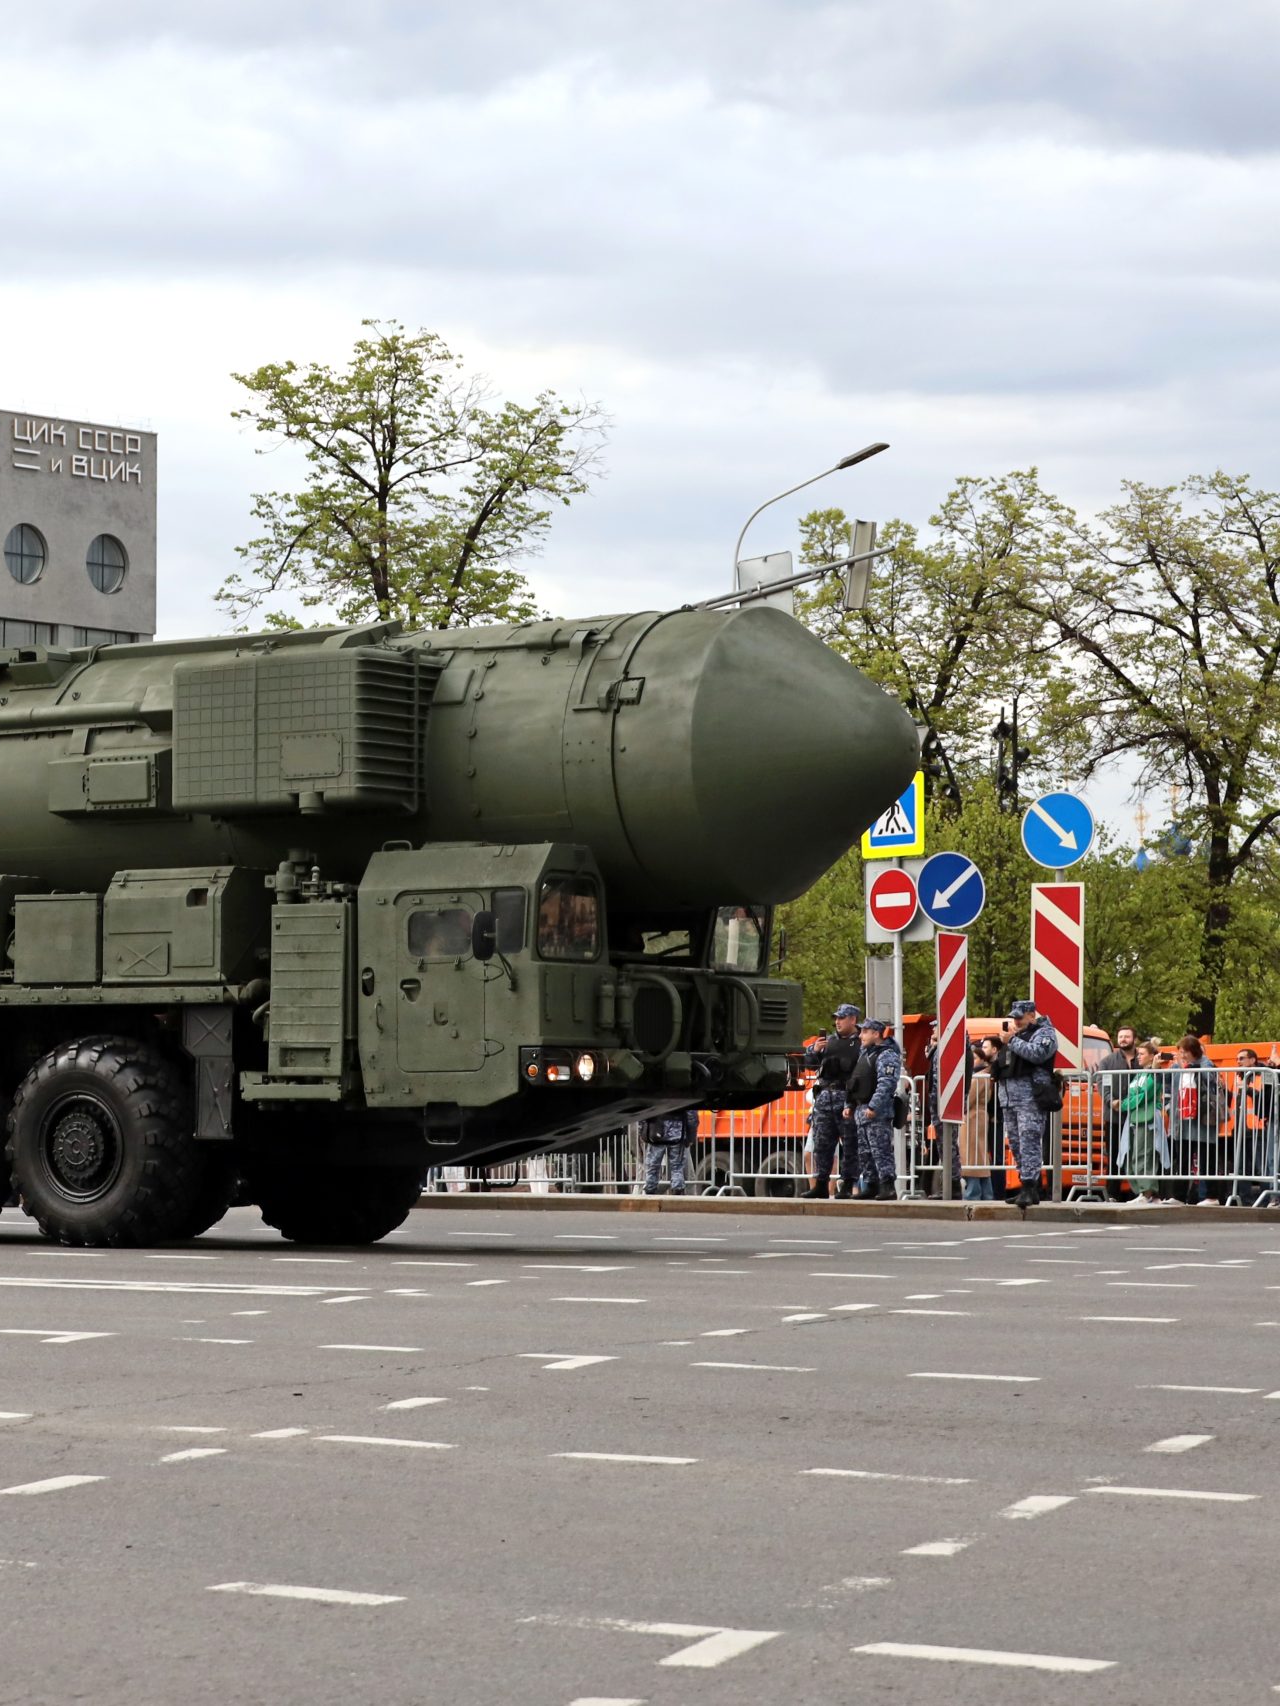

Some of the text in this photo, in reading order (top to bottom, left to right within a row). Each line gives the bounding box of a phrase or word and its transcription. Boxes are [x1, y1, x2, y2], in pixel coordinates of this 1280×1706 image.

[13, 418, 141, 454] ЦИК СССР
[72, 454, 141, 483] ВЦИК
